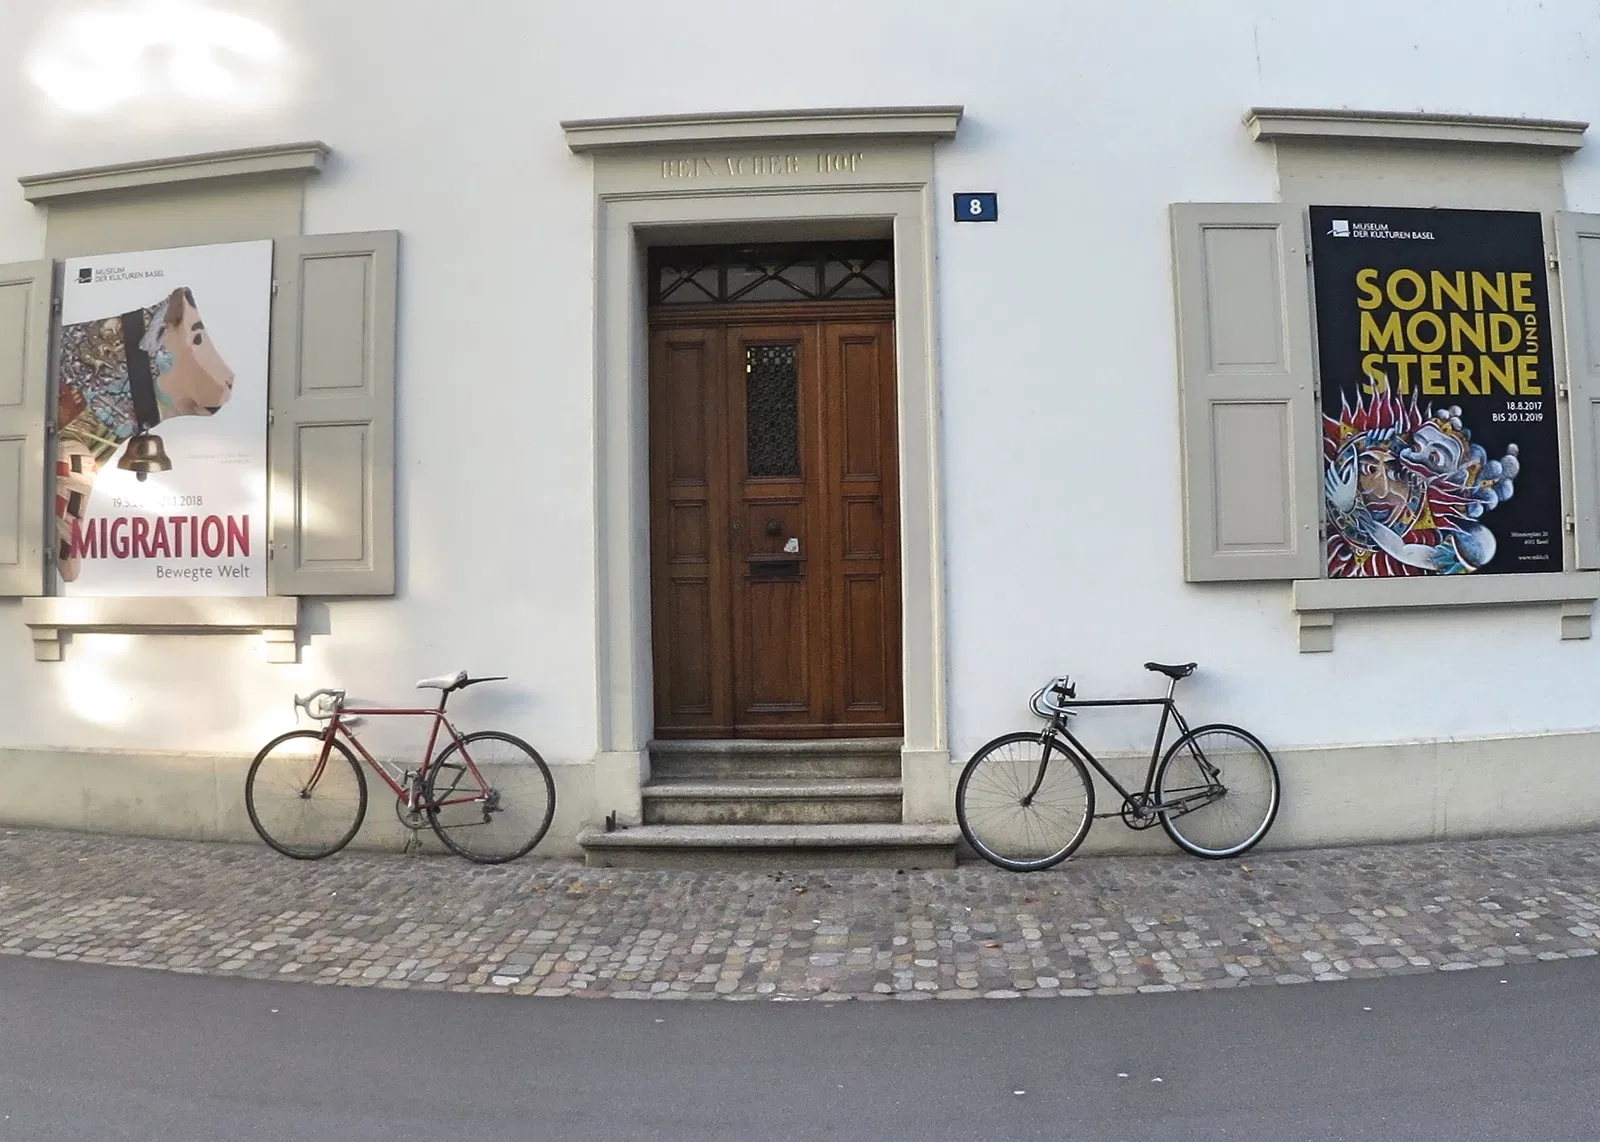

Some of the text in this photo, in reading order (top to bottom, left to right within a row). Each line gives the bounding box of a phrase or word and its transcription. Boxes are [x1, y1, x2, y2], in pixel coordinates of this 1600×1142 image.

[661, 152, 863, 178] REINACHER HOF
[970, 199, 982, 215] 8
[1352, 223, 1388, 231] MUSEUM
[1353, 230, 1435, 240] DER KULTUREN BASEL
[95, 267, 125, 275] MUSEUM
[109, 271, 144, 281] KULTUREN
[145, 270, 165, 278] BASEL
[1356, 268, 1536, 312] SONNE
[1360, 311, 1522, 353] MOND
[1524, 313, 1540, 353] UND
[1361, 353, 1542, 396] STERNE
[1506, 401, 1543, 410] 18.8.2017
[1492, 413, 1544, 421] BIS 20.1.2019
[70, 515, 250, 559] MIGRATION
[156, 564, 250, 581] Bewegte Welt
